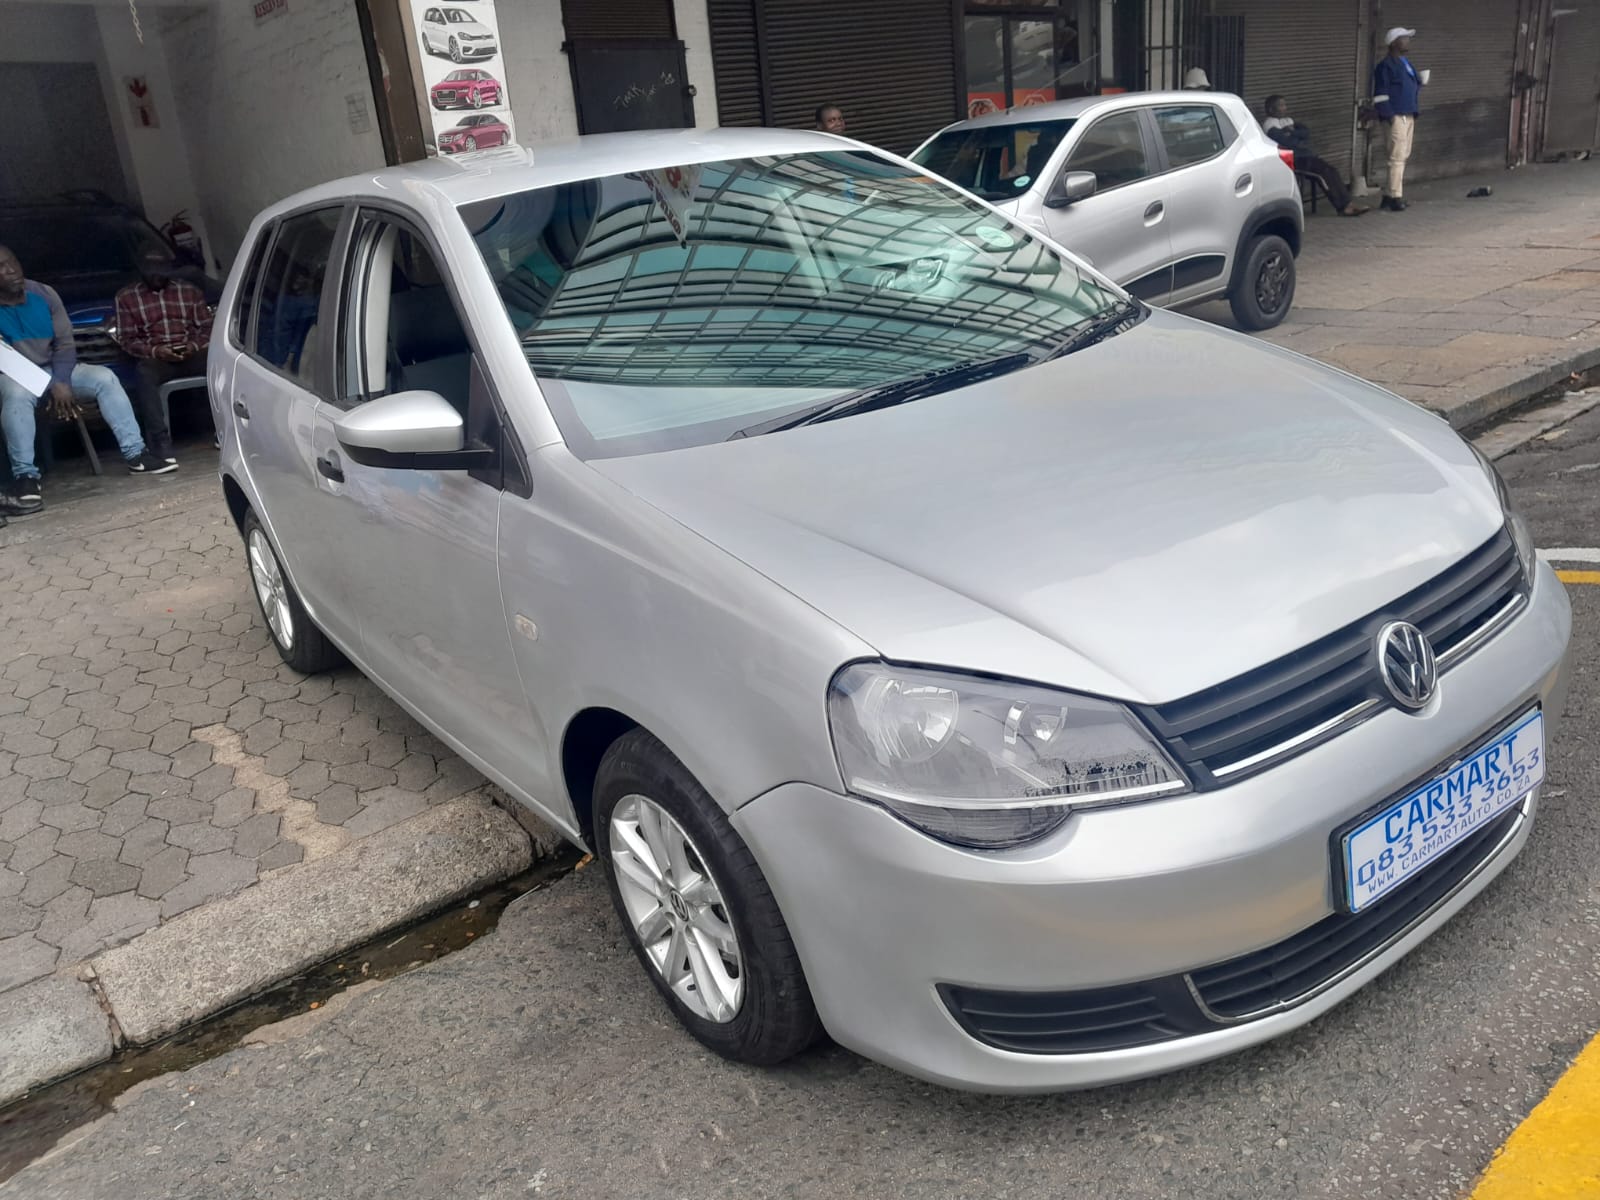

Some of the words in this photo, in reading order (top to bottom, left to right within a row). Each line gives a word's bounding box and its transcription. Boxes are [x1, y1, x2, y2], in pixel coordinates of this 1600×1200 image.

[1357, 833, 1414, 887] 083
[1422, 793, 1473, 843] 533
[1481, 747, 1540, 803] 3653
[1385, 735, 1518, 844] CARMART
